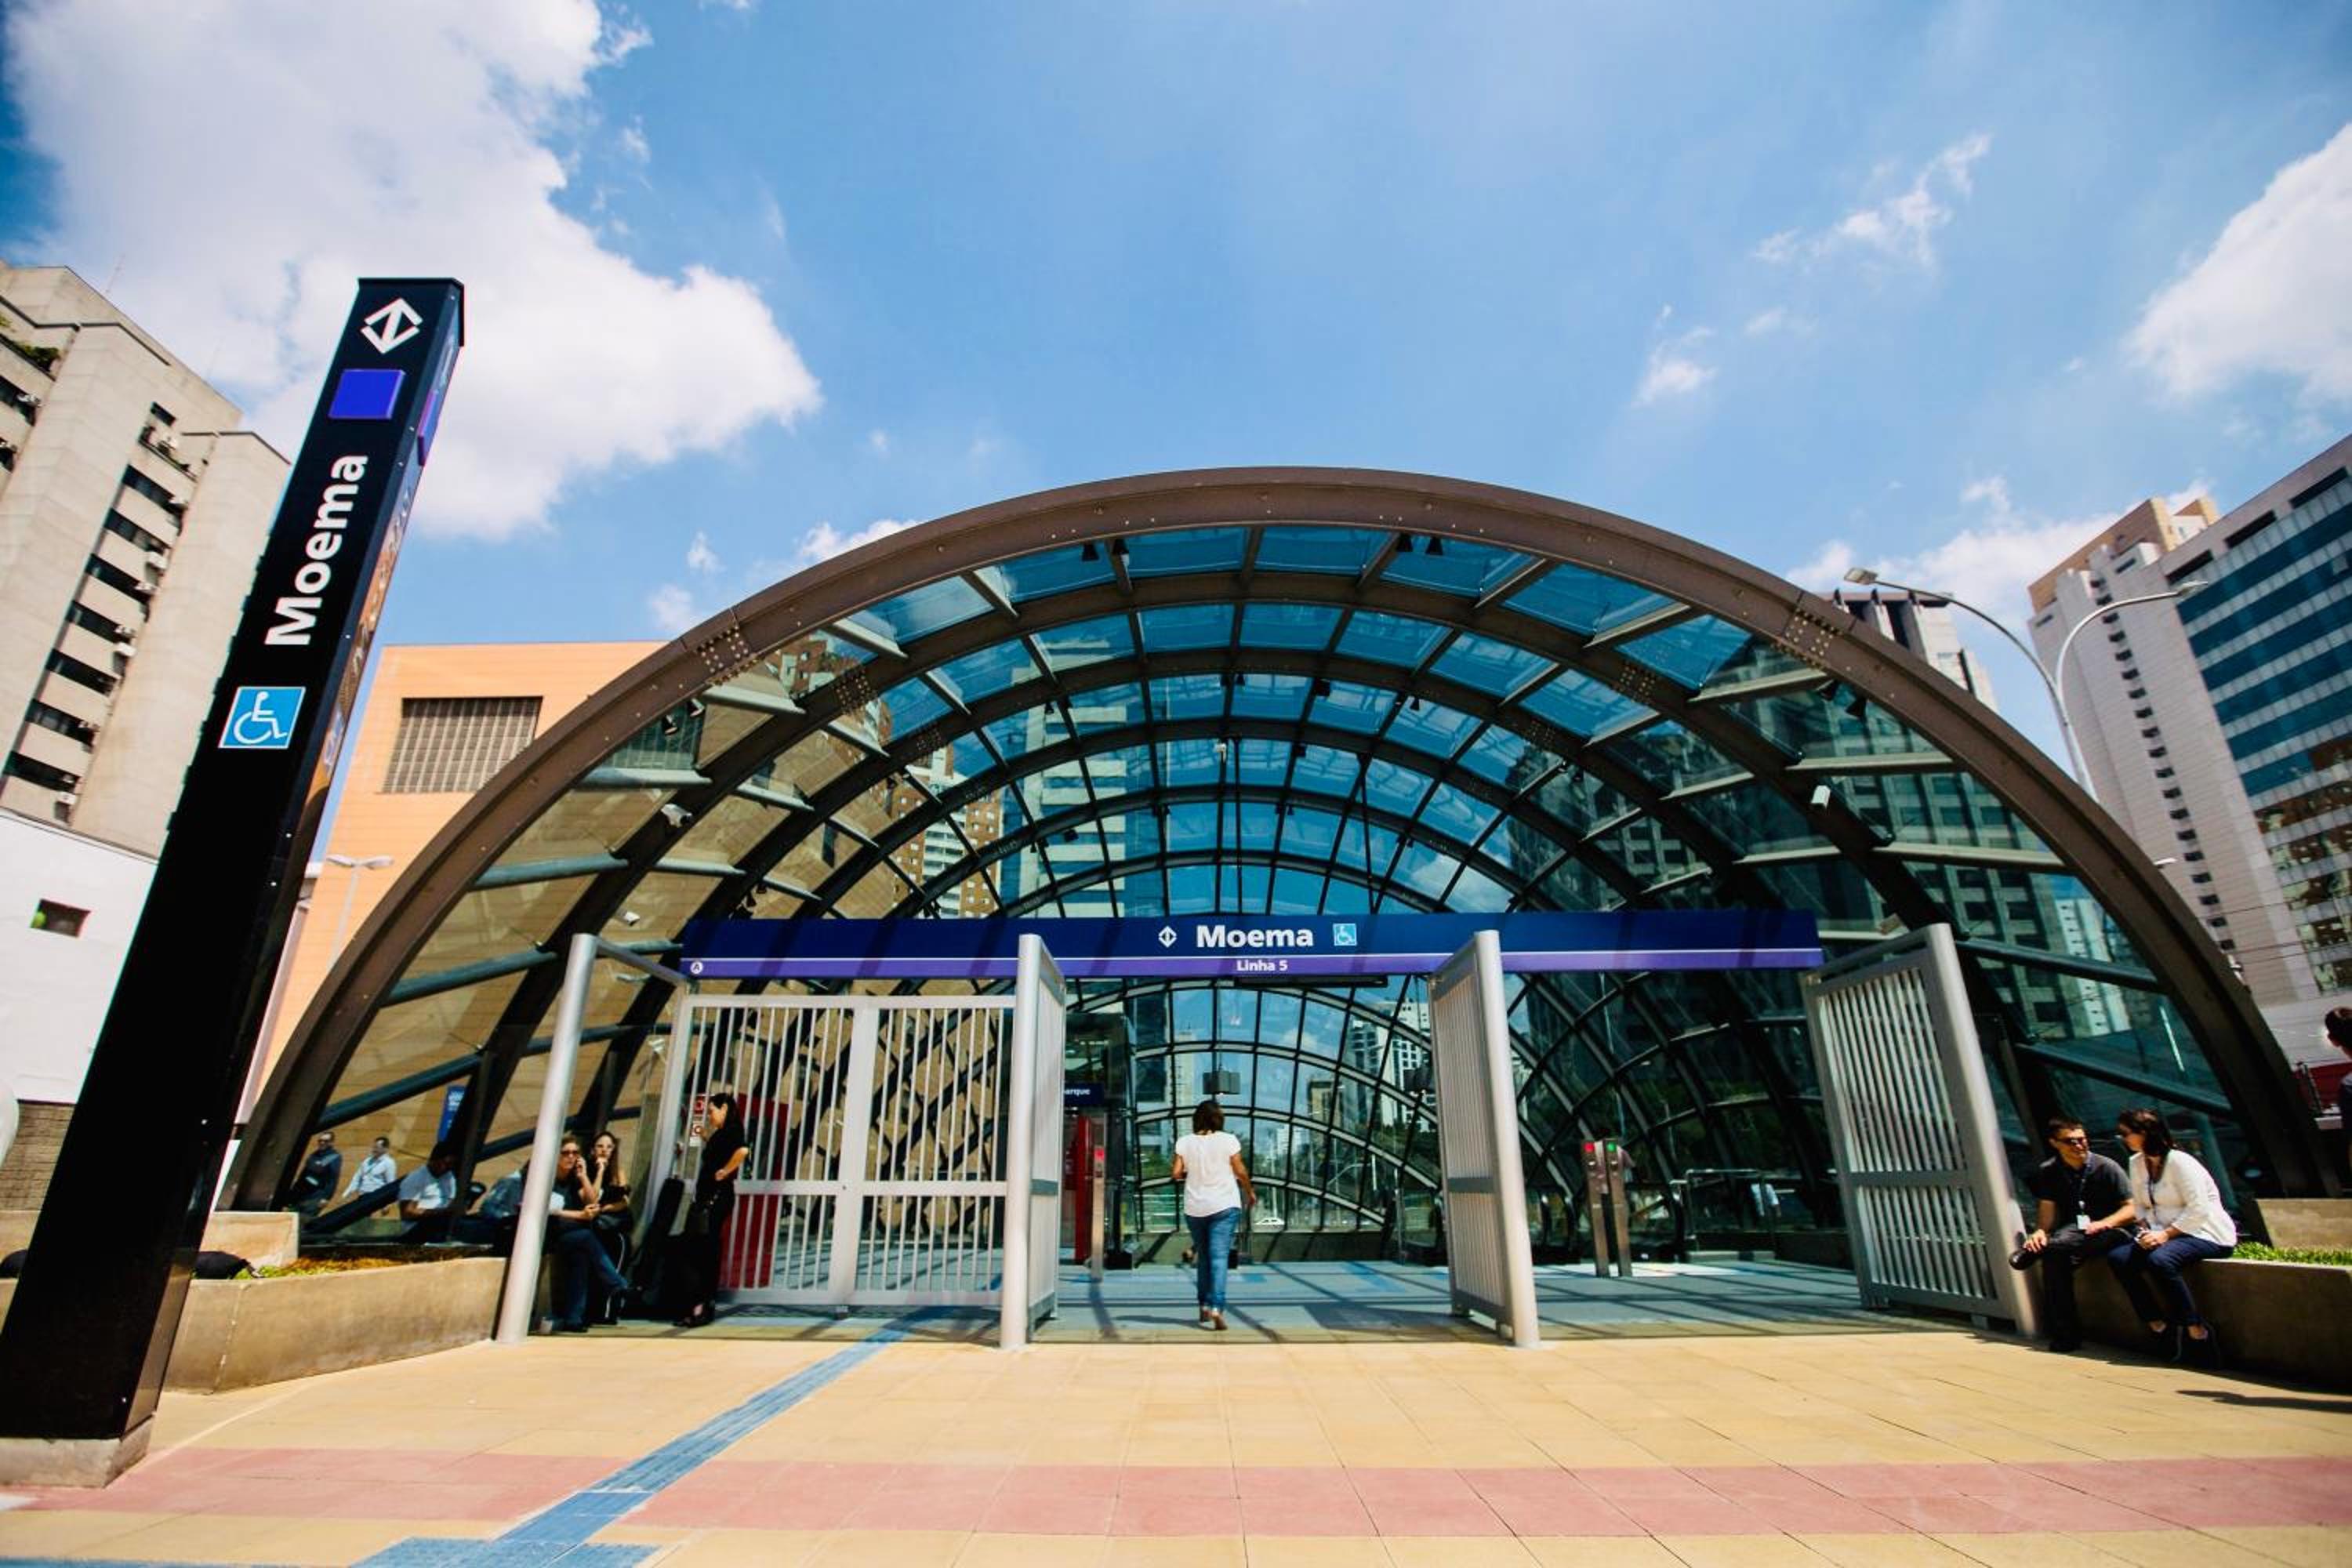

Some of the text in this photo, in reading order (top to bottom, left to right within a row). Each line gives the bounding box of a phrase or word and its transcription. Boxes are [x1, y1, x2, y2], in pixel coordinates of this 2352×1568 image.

[264, 456, 368, 645] Moema
[1196, 924, 1313, 948] Moema
[1236, 959, 1288, 971] Linha 5
